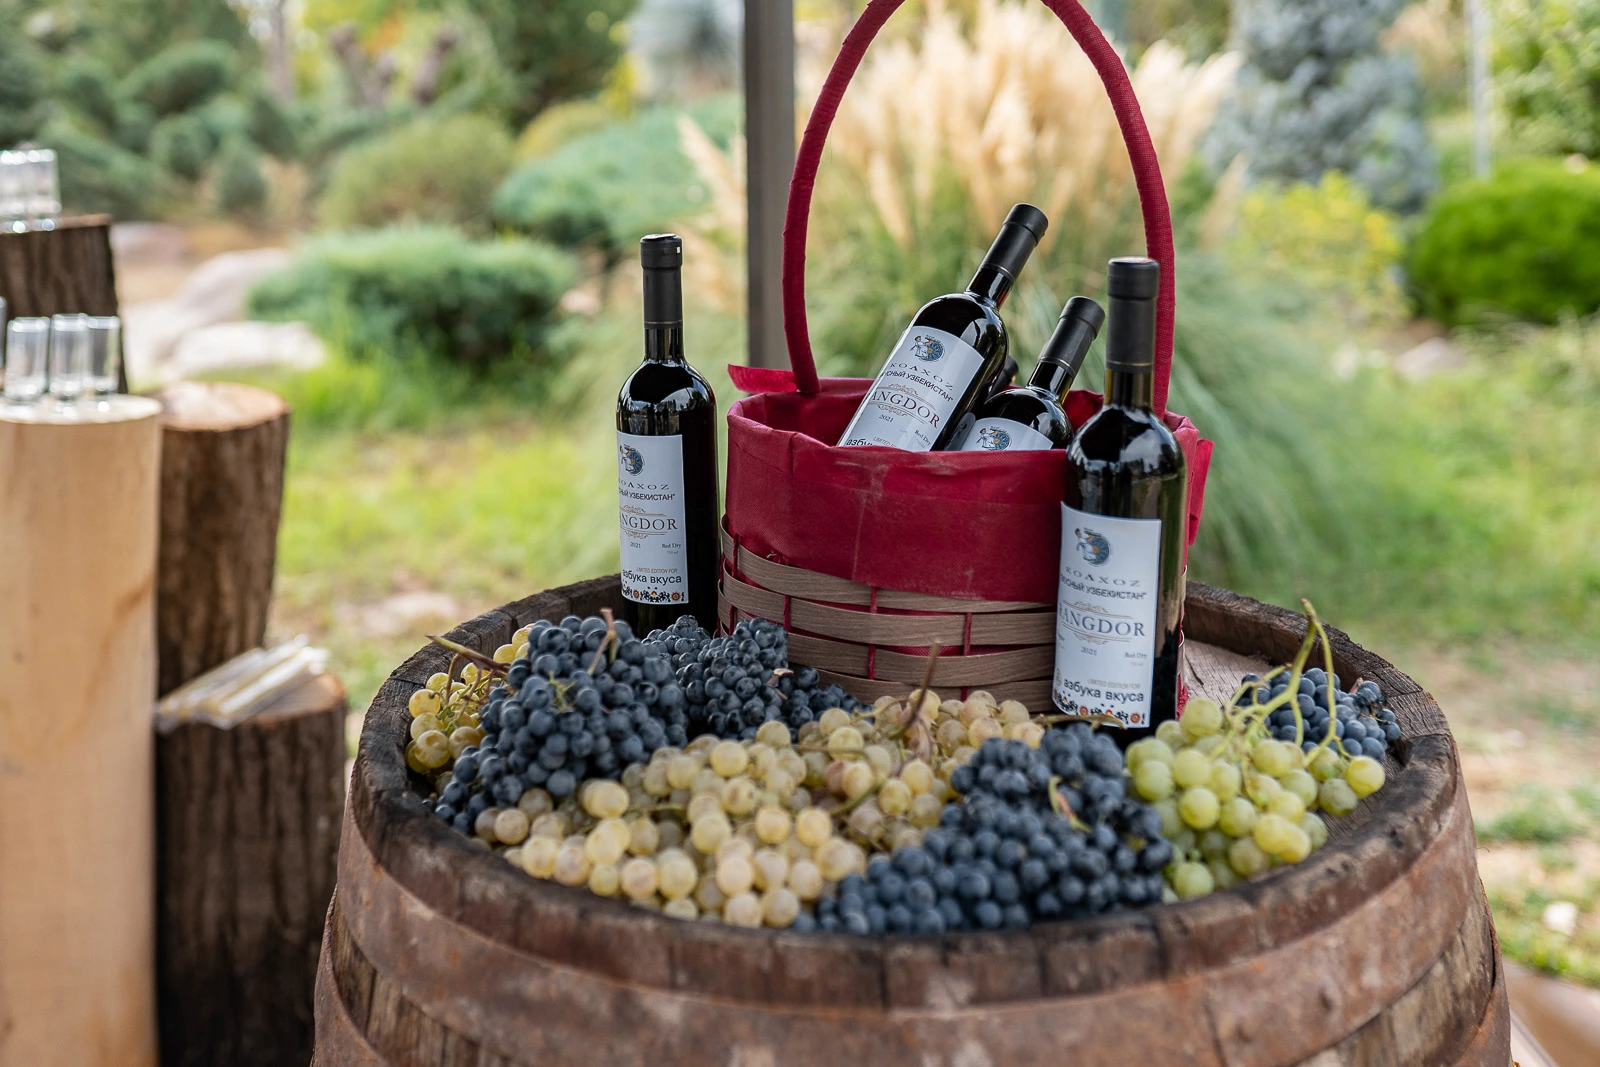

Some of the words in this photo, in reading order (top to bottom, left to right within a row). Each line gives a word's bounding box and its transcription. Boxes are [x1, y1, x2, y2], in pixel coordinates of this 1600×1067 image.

[871, 390, 940, 429] ANGDOR
[879, 413, 894, 423] 2021
[620, 512, 678, 531] NGDOR
[630, 541, 641, 549] 2021
[671, 542, 681, 550] Dry
[650, 575, 682, 586] вкуса
[1080, 646, 1098, 657] 2021
[1063, 678, 1102, 698] азбука
[1105, 690, 1145, 704] вкуса
